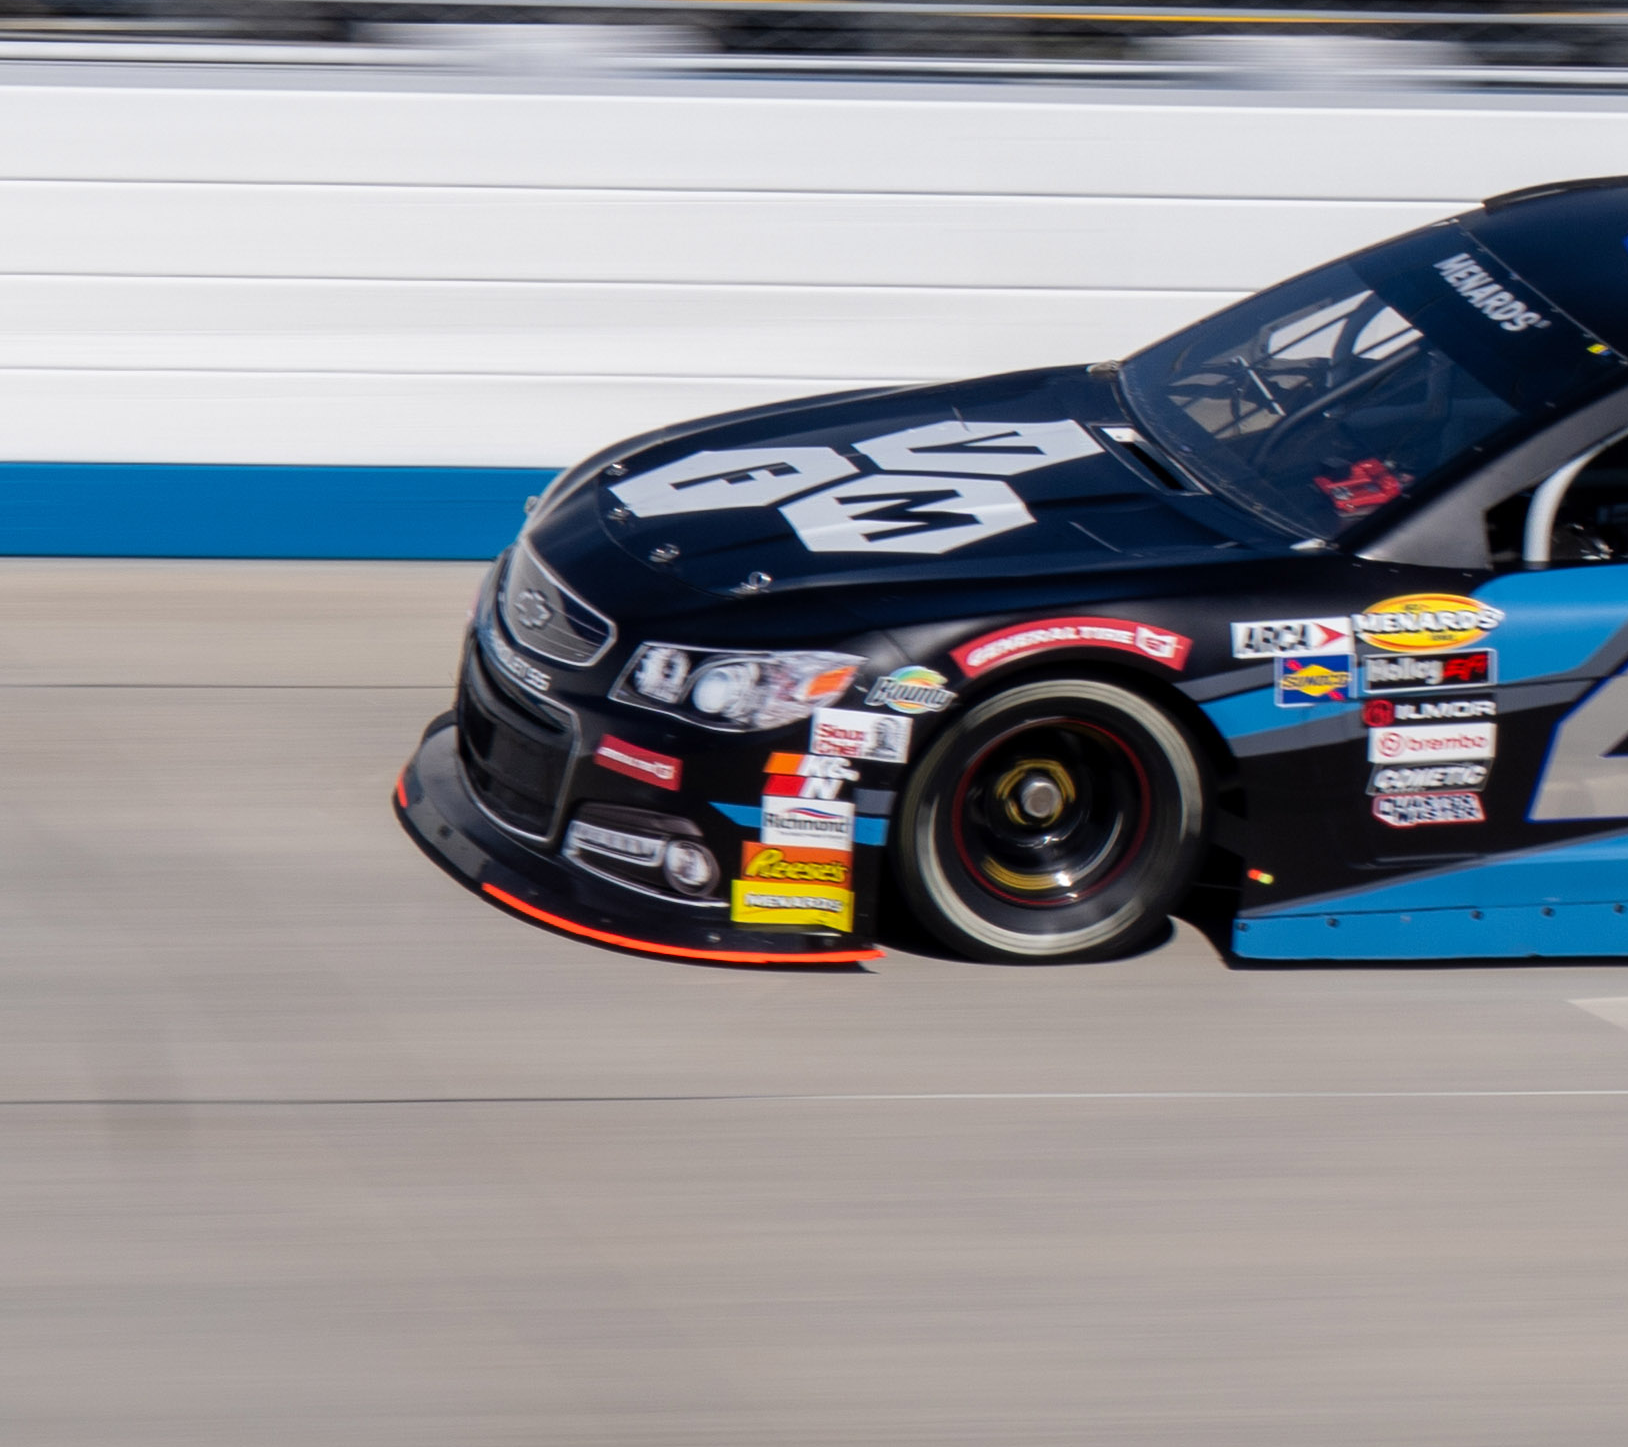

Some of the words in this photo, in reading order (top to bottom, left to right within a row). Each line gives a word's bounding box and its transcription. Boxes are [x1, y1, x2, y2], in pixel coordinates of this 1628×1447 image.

[1432, 253, 1542, 331] MENARDS
[1353, 607, 1503, 633] MENARDS
[1244, 622, 1312, 652] ARCA
[1366, 657, 1444, 685] Holley
[1404, 734, 1488, 752] brembo
[763, 811, 850, 834] Richmond
